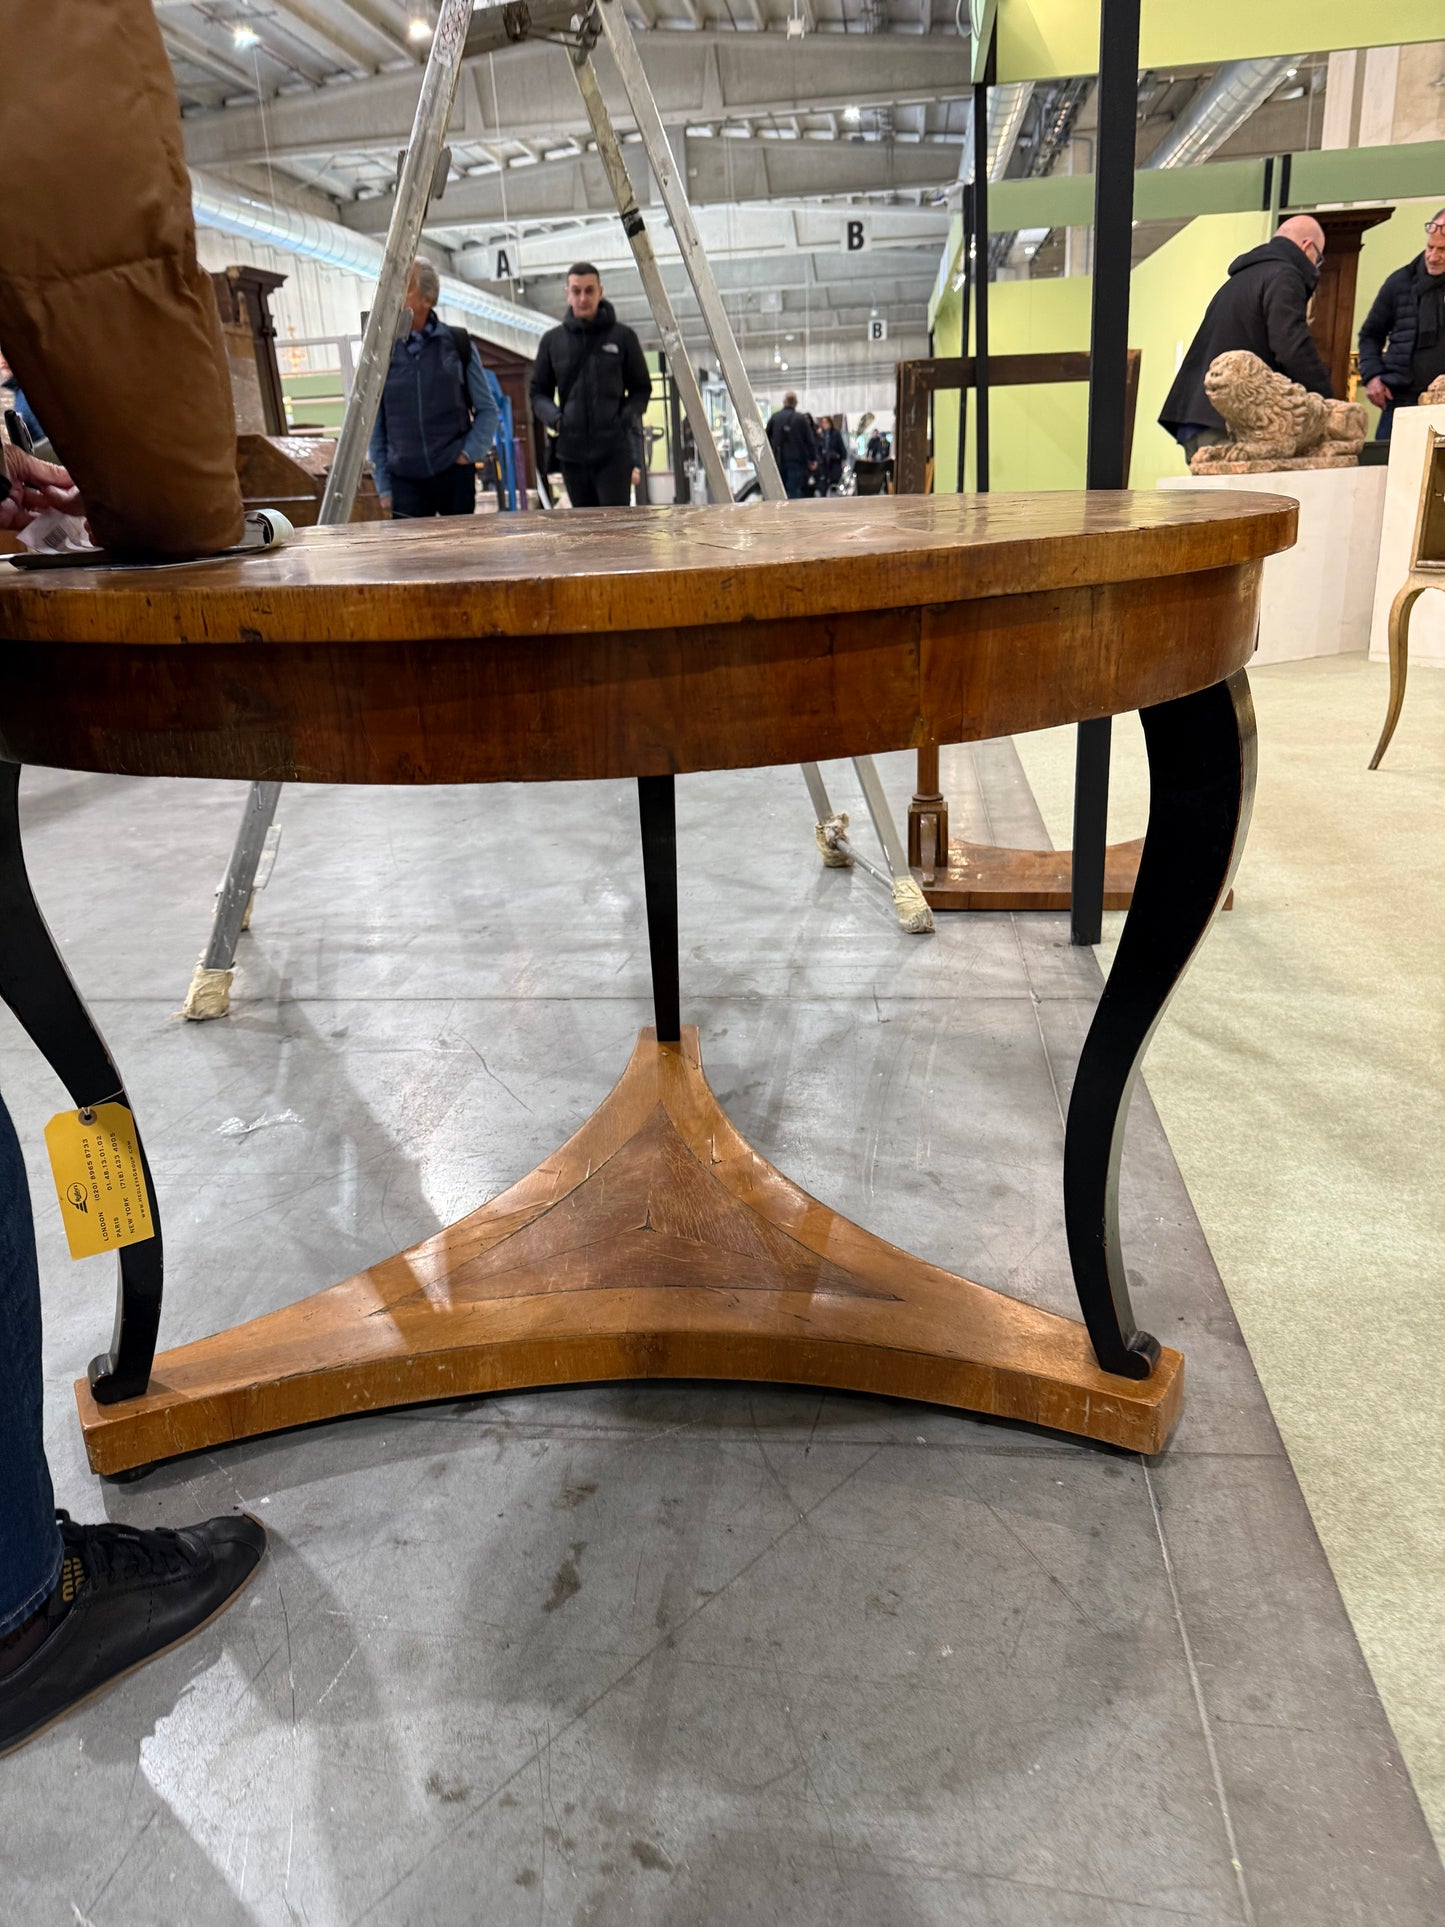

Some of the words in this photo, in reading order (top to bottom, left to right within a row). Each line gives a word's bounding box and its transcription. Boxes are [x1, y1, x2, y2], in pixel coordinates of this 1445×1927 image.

[847, 221, 864, 250] B
[497, 250, 512, 278] A
[873, 323, 882, 339] B
[83, 1139, 91, 1158] 8733
[110, 1132, 118, 1152] 4005
[87, 1161, 95, 1180] 8965
[114, 1155, 122, 1169] 433
[92, 1182, 100, 1200] (020)
[123, 1197, 131, 1217] YORK
[99, 1212, 108, 1241] LONDON
[113, 1217, 122, 1238] PARIS
[127, 1219, 135, 1233] NEW
